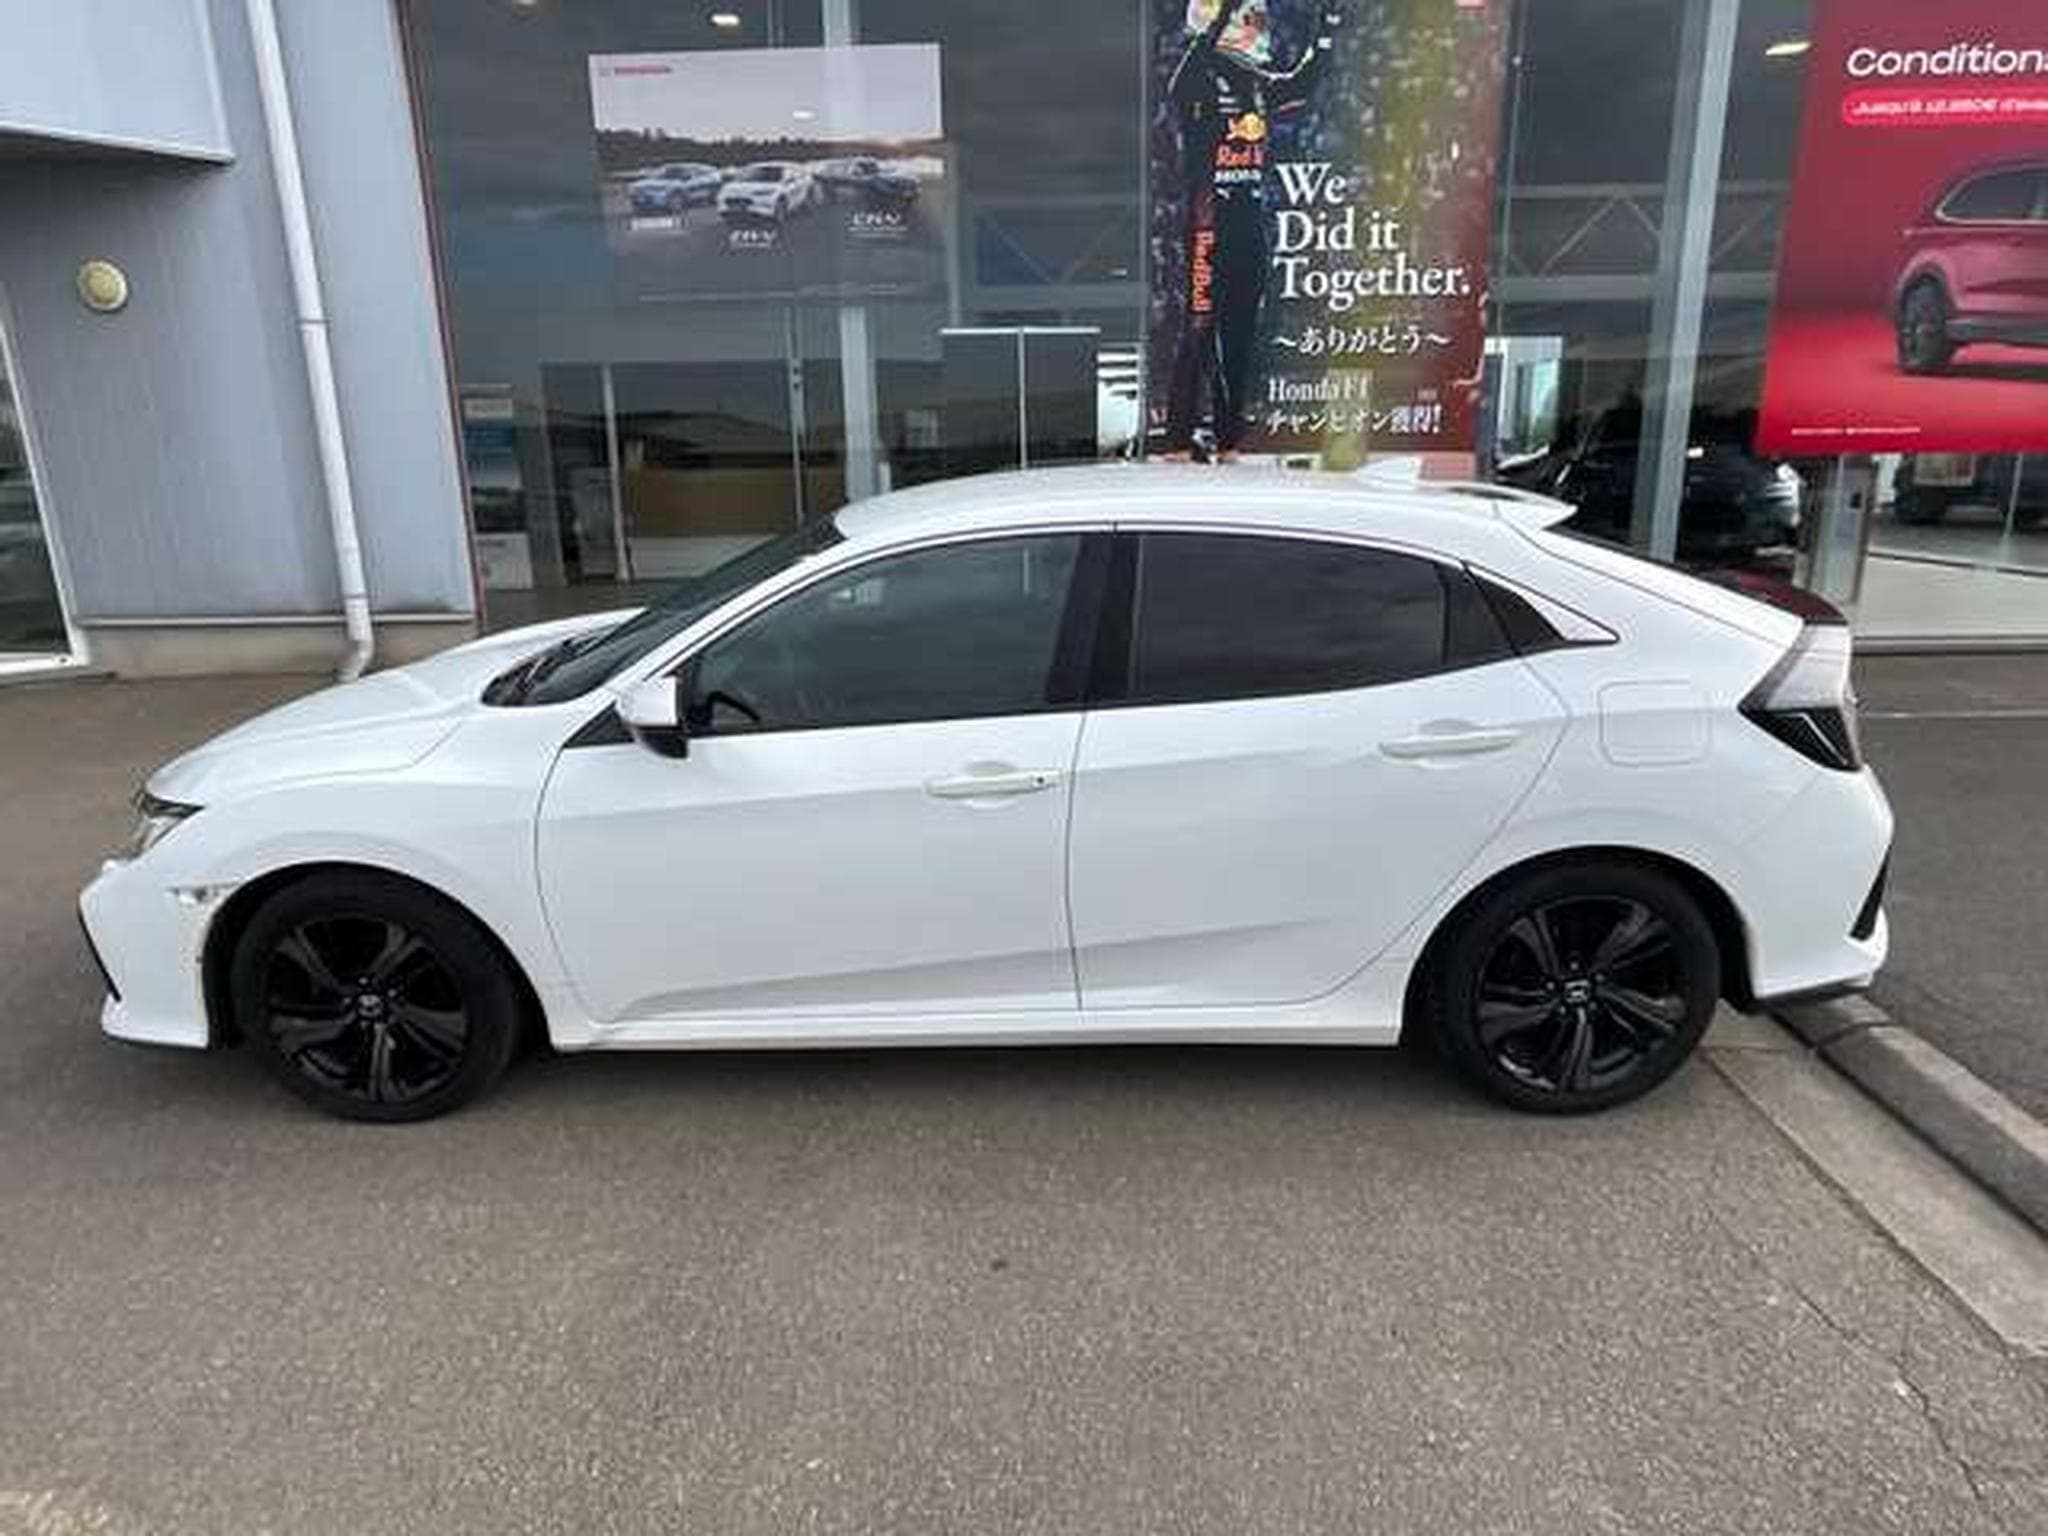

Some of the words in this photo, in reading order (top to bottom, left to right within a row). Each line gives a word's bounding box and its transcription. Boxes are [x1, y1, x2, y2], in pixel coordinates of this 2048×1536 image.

[1275, 164, 1346, 205] We
[1274, 208, 1354, 252] Did
[1369, 211, 1400, 250] it
[1273, 252, 1471, 311] Together.
[1267, 377, 1340, 402] Honda
